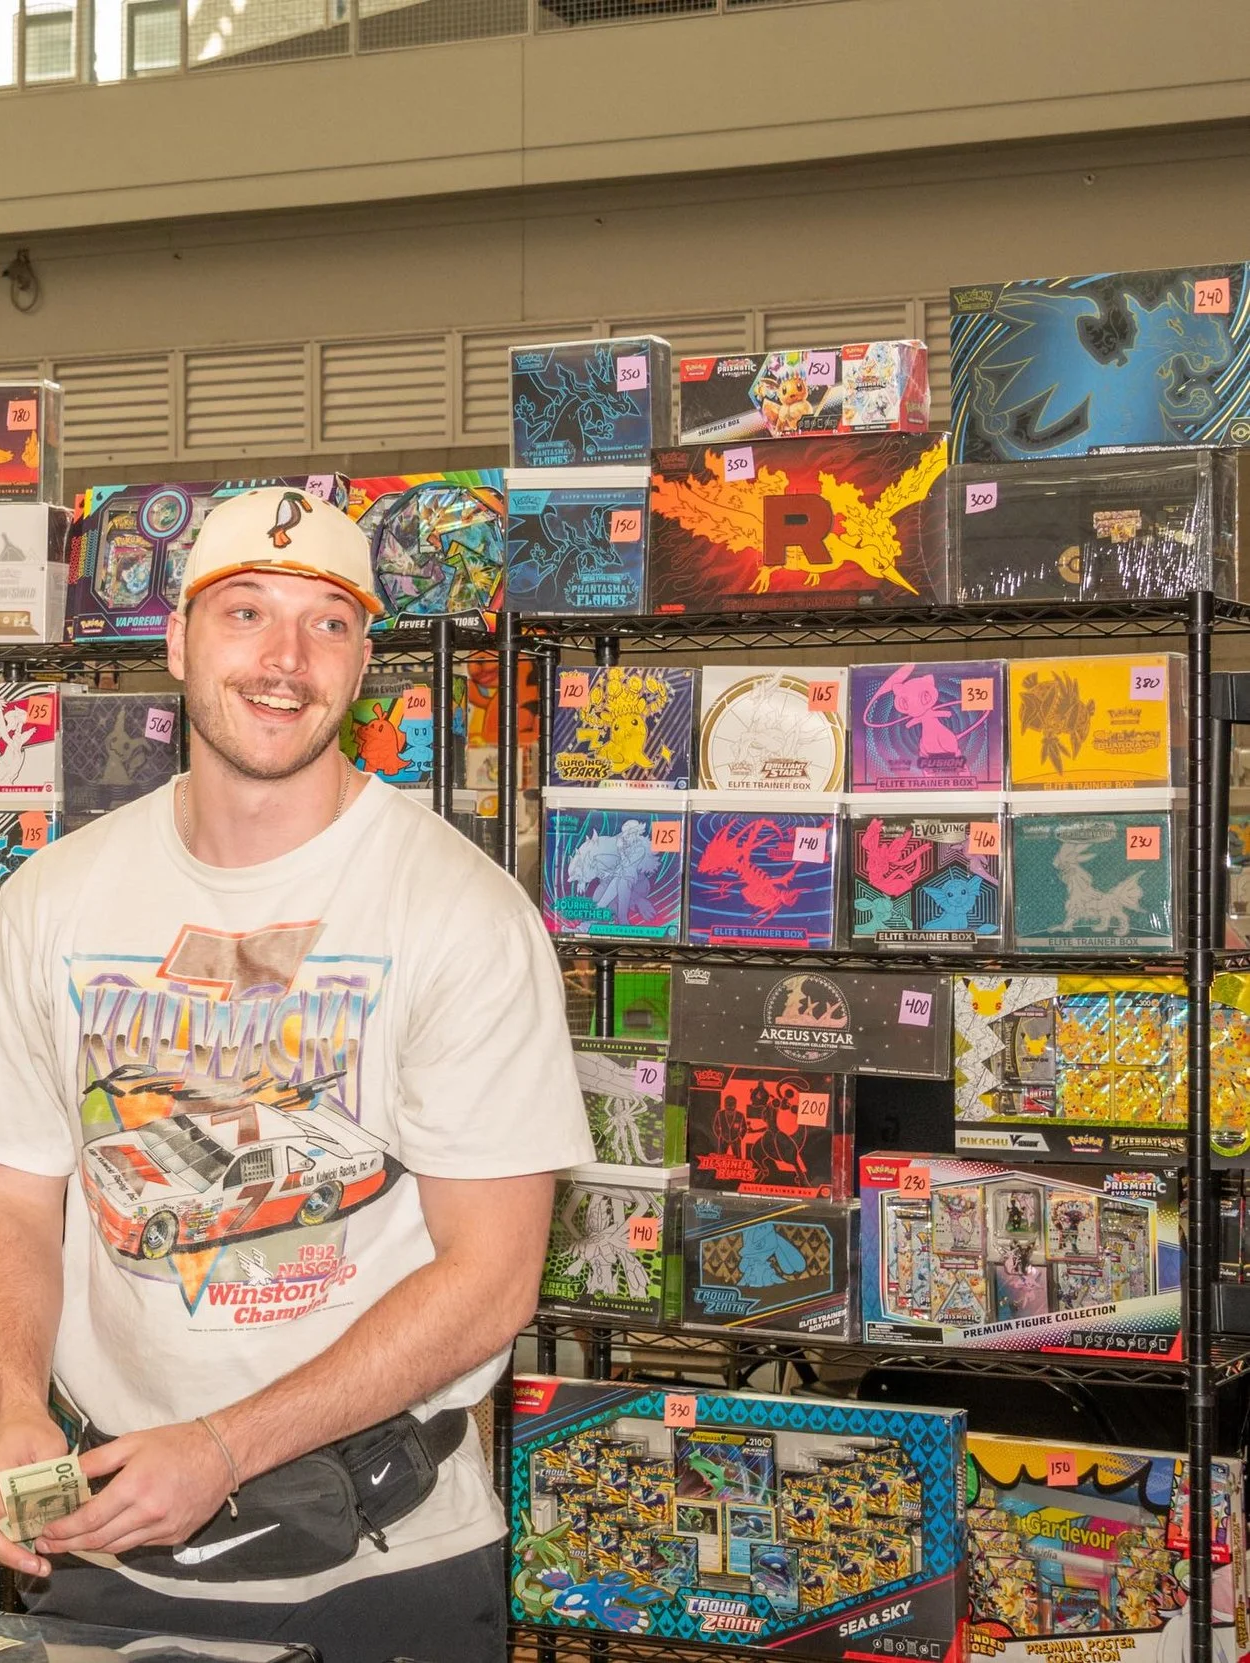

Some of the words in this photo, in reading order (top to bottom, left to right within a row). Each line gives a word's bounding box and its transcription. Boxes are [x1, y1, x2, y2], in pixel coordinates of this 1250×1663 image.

[1197, 288, 1224, 307] 240
[620, 367, 640, 382] 350
[717, 364, 757, 375] PRISMATIC
[808, 361, 830, 376] 150
[12, 408, 30, 422] 780
[698, 422, 727, 437] SURPRISE
[727, 418, 741, 430] BOX
[726, 458, 748, 472] 350
[970, 493, 993, 507] 300
[614, 519, 637, 534] 150
[762, 493, 834, 566] R
[570, 584, 633, 594] PHANTASMAL
[576, 593, 627, 607] FLAMES
[115, 615, 163, 627] VAPOREON
[1135, 676, 1161, 690] 380
[563, 684, 584, 699] 120
[966, 687, 988, 701] 330
[407, 696, 426, 710] 200
[28, 703, 48, 718] 135
[556, 759, 605, 769] SURGING
[763, 761, 807, 772] BRILLIANT
[920, 758, 965, 768] FUSION
[561, 766, 609, 779] SPARKS
[768, 768, 803, 779] STARS
[728, 780, 750, 790] ELITE
[750, 781, 791, 790] TRAINER
[792, 781, 812, 791] BOX
[879, 779, 904, 788] ELITE
[906, 779, 951, 788] TRAINER
[952, 778, 974, 788] BOX
[1043, 782, 1070, 791] ELITE
[1071, 781, 1113, 790] TRAINER
[1115, 780, 1136, 789] BOX
[25, 826, 42, 841] 135
[914, 822, 965, 837] EVOLVING
[655, 829, 675, 845] 125
[798, 837, 819, 851] 140
[1129, 835, 1153, 848] 230
[553, 900, 594, 911] JOURNEY
[562, 909, 611, 920] TOGETHER
[713, 927, 741, 937] ELITE
[741, 928, 782, 938] TRAINER
[783, 929, 805, 939] BOX
[878, 932, 906, 941] ELITE
[906, 932, 950, 941] TRAINER
[951, 932, 973, 942] BOX
[1048, 937, 1075, 946] ELITE
[1075, 937, 1116, 946] TRAINER
[1117, 937, 1139, 946] BOX
[904, 999, 930, 1016] 400
[759, 1028, 810, 1042] ARCEUS
[812, 1031, 854, 1045] VSTAR
[639, 1068, 658, 1084] 70
[800, 1101, 827, 1118] 200
[959, 1136, 1009, 1146] PIKACHU
[1111, 1135, 1188, 1150] CELEBRATIONS
[301, 1172, 315, 1187] Alan
[315, 1168, 339, 1185] Kulwicki
[338, 1162, 358, 1182] Racing,
[903, 1175, 926, 1191] 230
[1103, 1180, 1168, 1194] PRISMATIC
[1110, 1190, 1157, 1198] EVOLUTIONS
[225, 1181, 275, 1234] 7
[633, 1225, 653, 1241] 140
[298, 1245, 336, 1262] 1992
[206, 1281, 319, 1307] Winston
[319, 1262, 358, 1295] Cup
[694, 1288, 736, 1302] CROWN
[704, 1301, 748, 1315] ZENITH
[798, 1317, 818, 1329] ELITE
[817, 1309, 848, 1325] TRAINER
[808, 1322, 823, 1332] BOX
[823, 1318, 841, 1330] PLUS
[962, 1321, 1014, 1340] PREMIUM
[1014, 1316, 1053, 1332] FIGURE
[1055, 1304, 1117, 1324] COLLECTION
[669, 1402, 691, 1418] 330
[750, 1437, 764, 1447] 210
[1050, 1461, 1071, 1475] 150
[1026, 1511, 1115, 1551] Gardevoir
[690, 1598, 747, 1615] CROWN
[701, 1614, 764, 1634] ZENITH
[838, 1618, 867, 1638] SEA
[867, 1613, 879, 1628] &
[880, 1600, 913, 1624] SKY
[1025, 1639, 1085, 1656] PREMIUM
[1087, 1636, 1136, 1651] POSTER
[1044, 1649, 1123, 1663] COLLECTION
